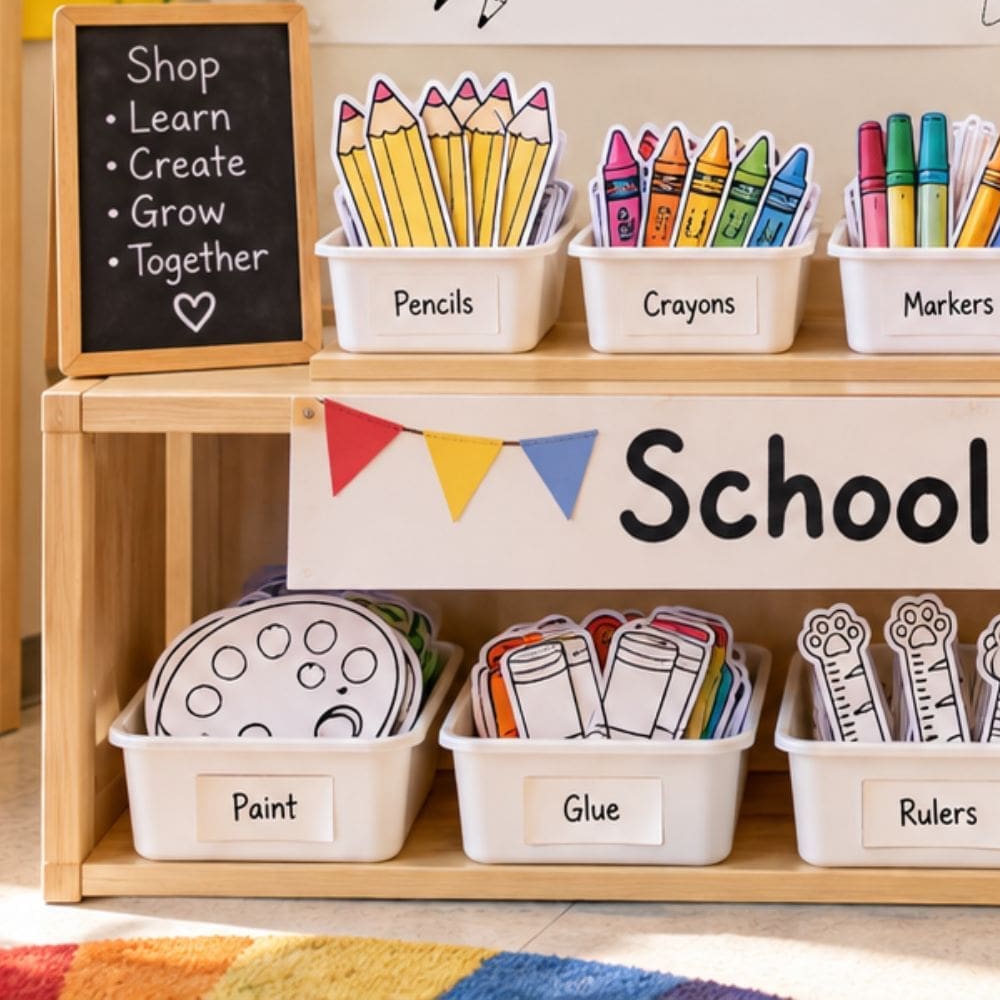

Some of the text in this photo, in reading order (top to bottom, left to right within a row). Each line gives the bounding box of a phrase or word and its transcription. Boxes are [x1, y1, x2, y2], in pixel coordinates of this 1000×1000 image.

[127, 45, 220, 94] Shop
[130, 100, 231, 133] Learn
[129, 145, 246, 180] Create
[131, 193, 225, 228] Grow
[127, 240, 269, 286] Together
[394, 288, 474, 317] Pencils
[643, 290, 736, 325] Crayons
[904, 290, 994, 318] Markers
[619, 428, 989, 545] School
[232, 792, 298, 822] Paint
[563, 793, 620, 823] Glue
[899, 797, 978, 827] Rulers
